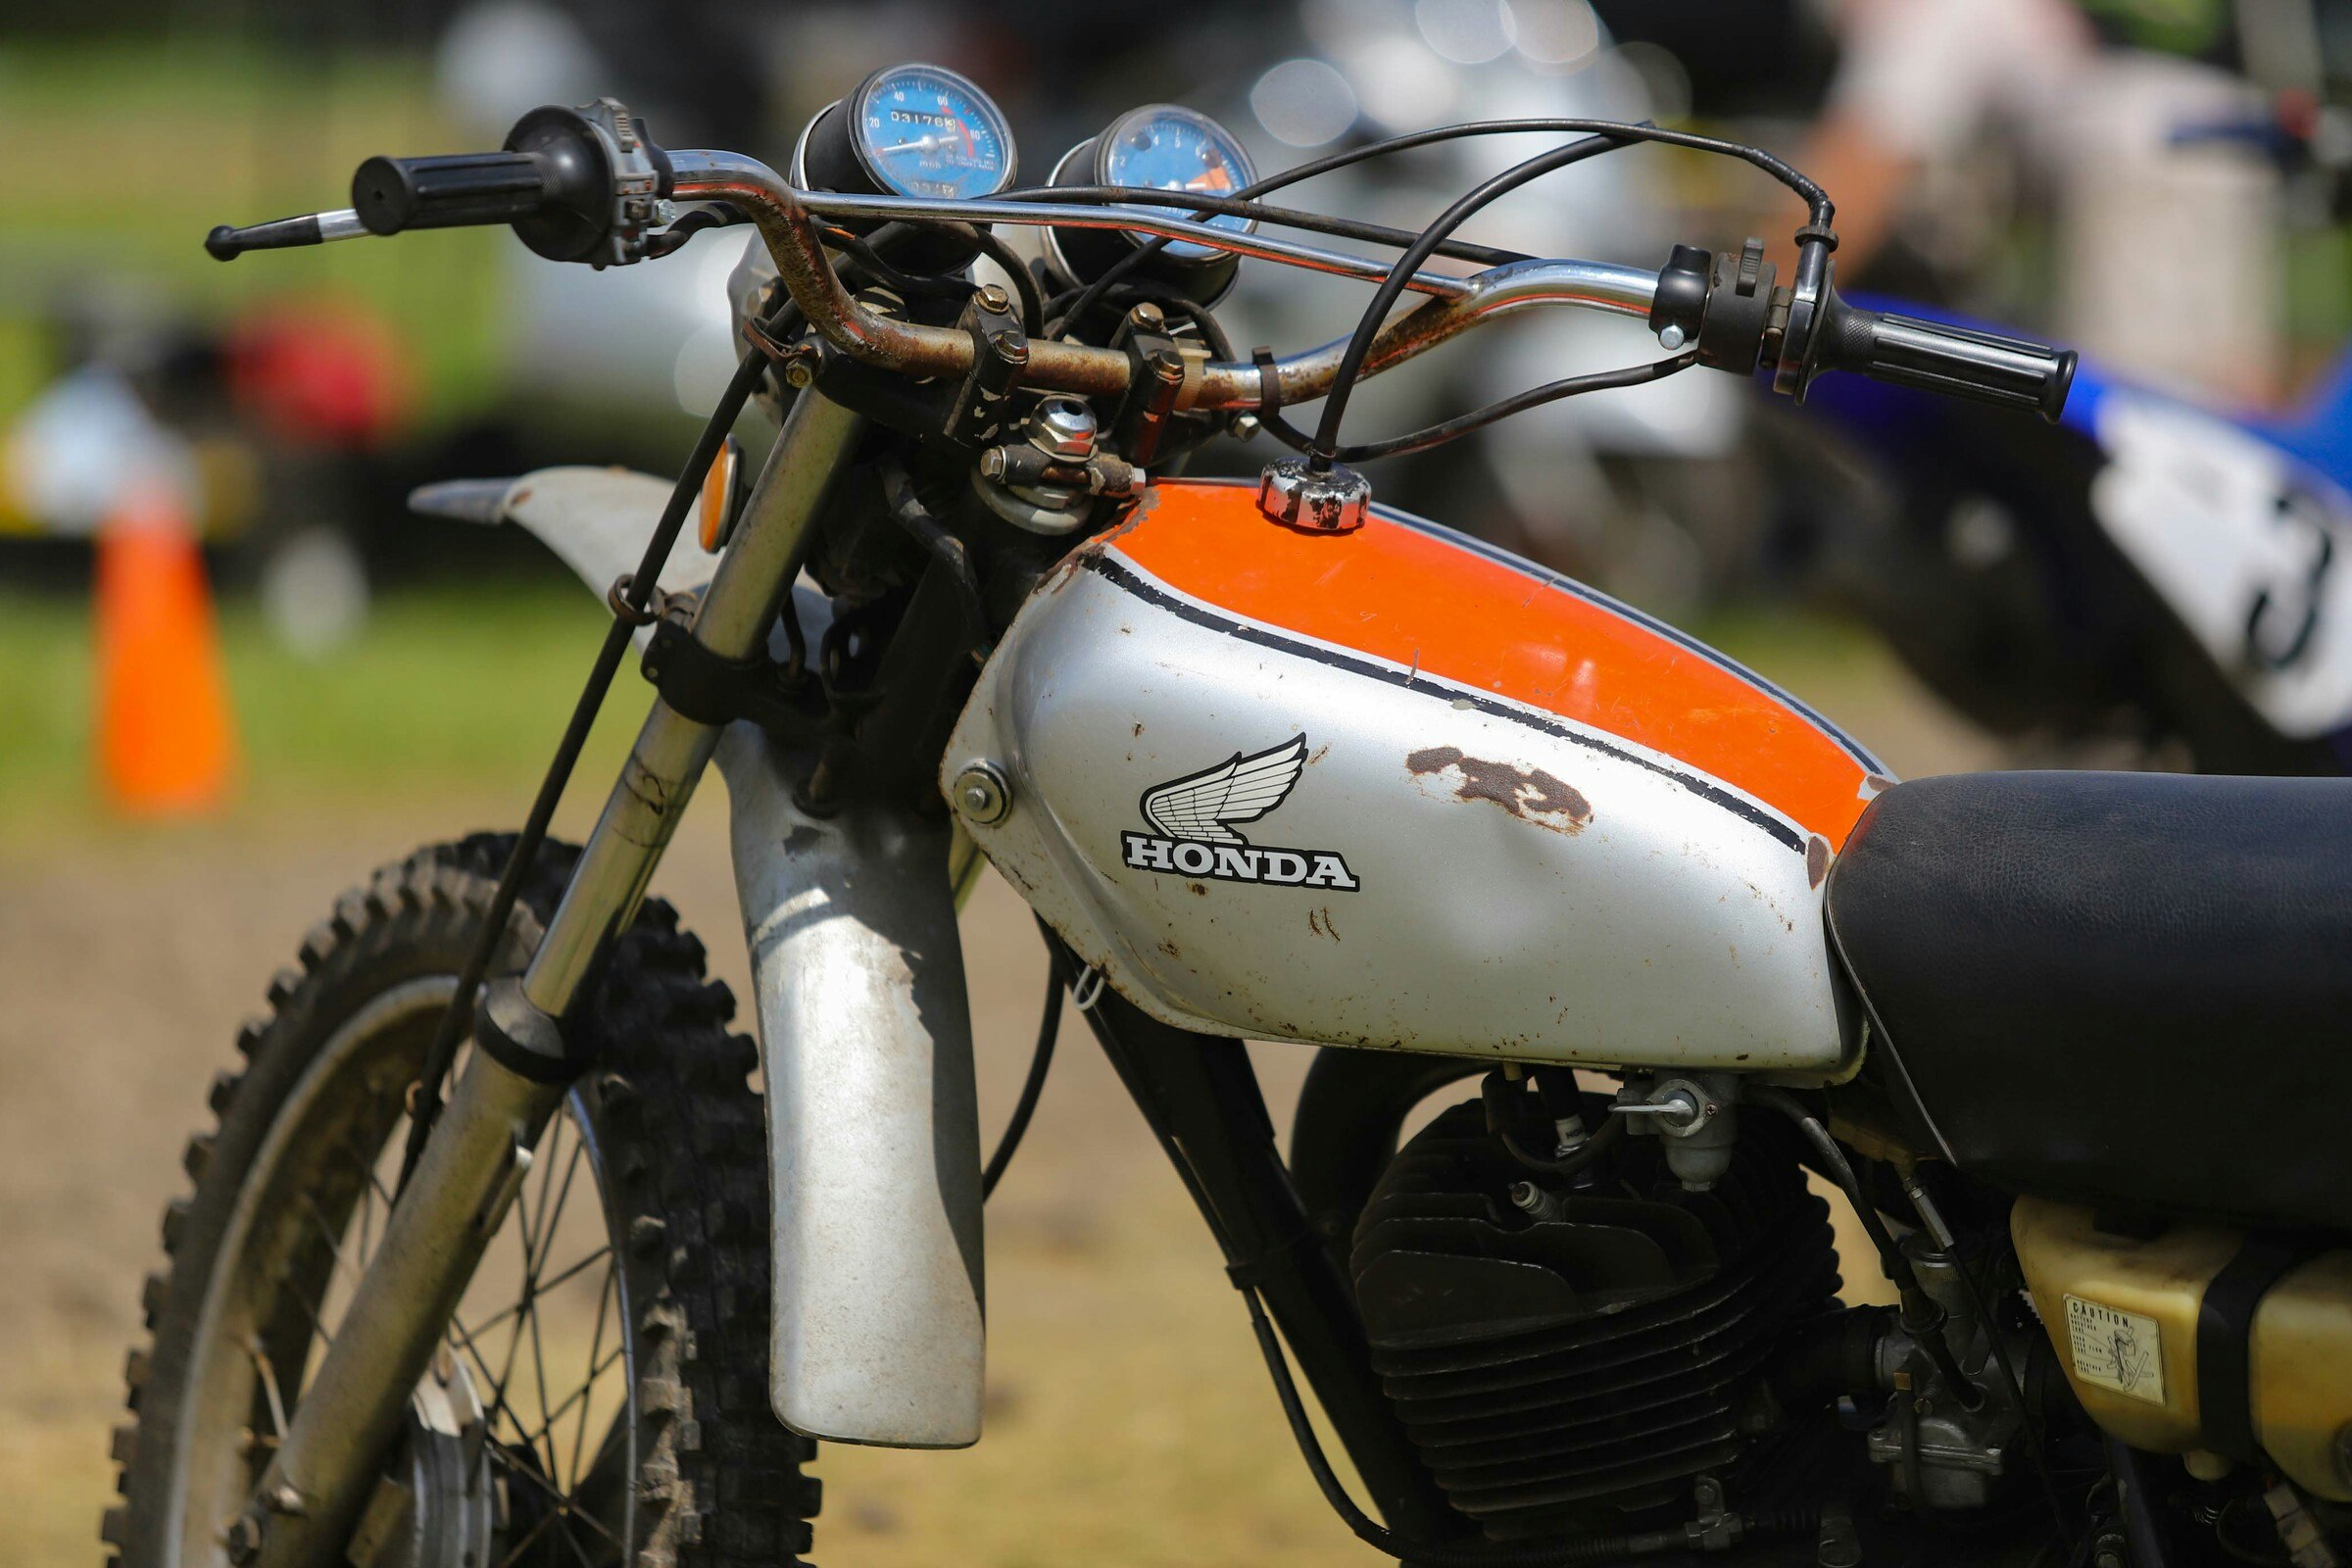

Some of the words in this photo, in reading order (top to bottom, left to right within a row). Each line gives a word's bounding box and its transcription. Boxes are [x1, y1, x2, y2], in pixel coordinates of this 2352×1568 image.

[893, 91, 905, 102] 40
[937, 96, 948, 106] 60
[869, 117, 880, 128] 20
[969, 129, 981, 141] 80
[1152, 134, 1159, 146] 4
[1119, 157, 1126, 167] 2
[1125, 835, 1357, 889] HONDA
[2073, 1301, 2129, 1328] CAUTION
